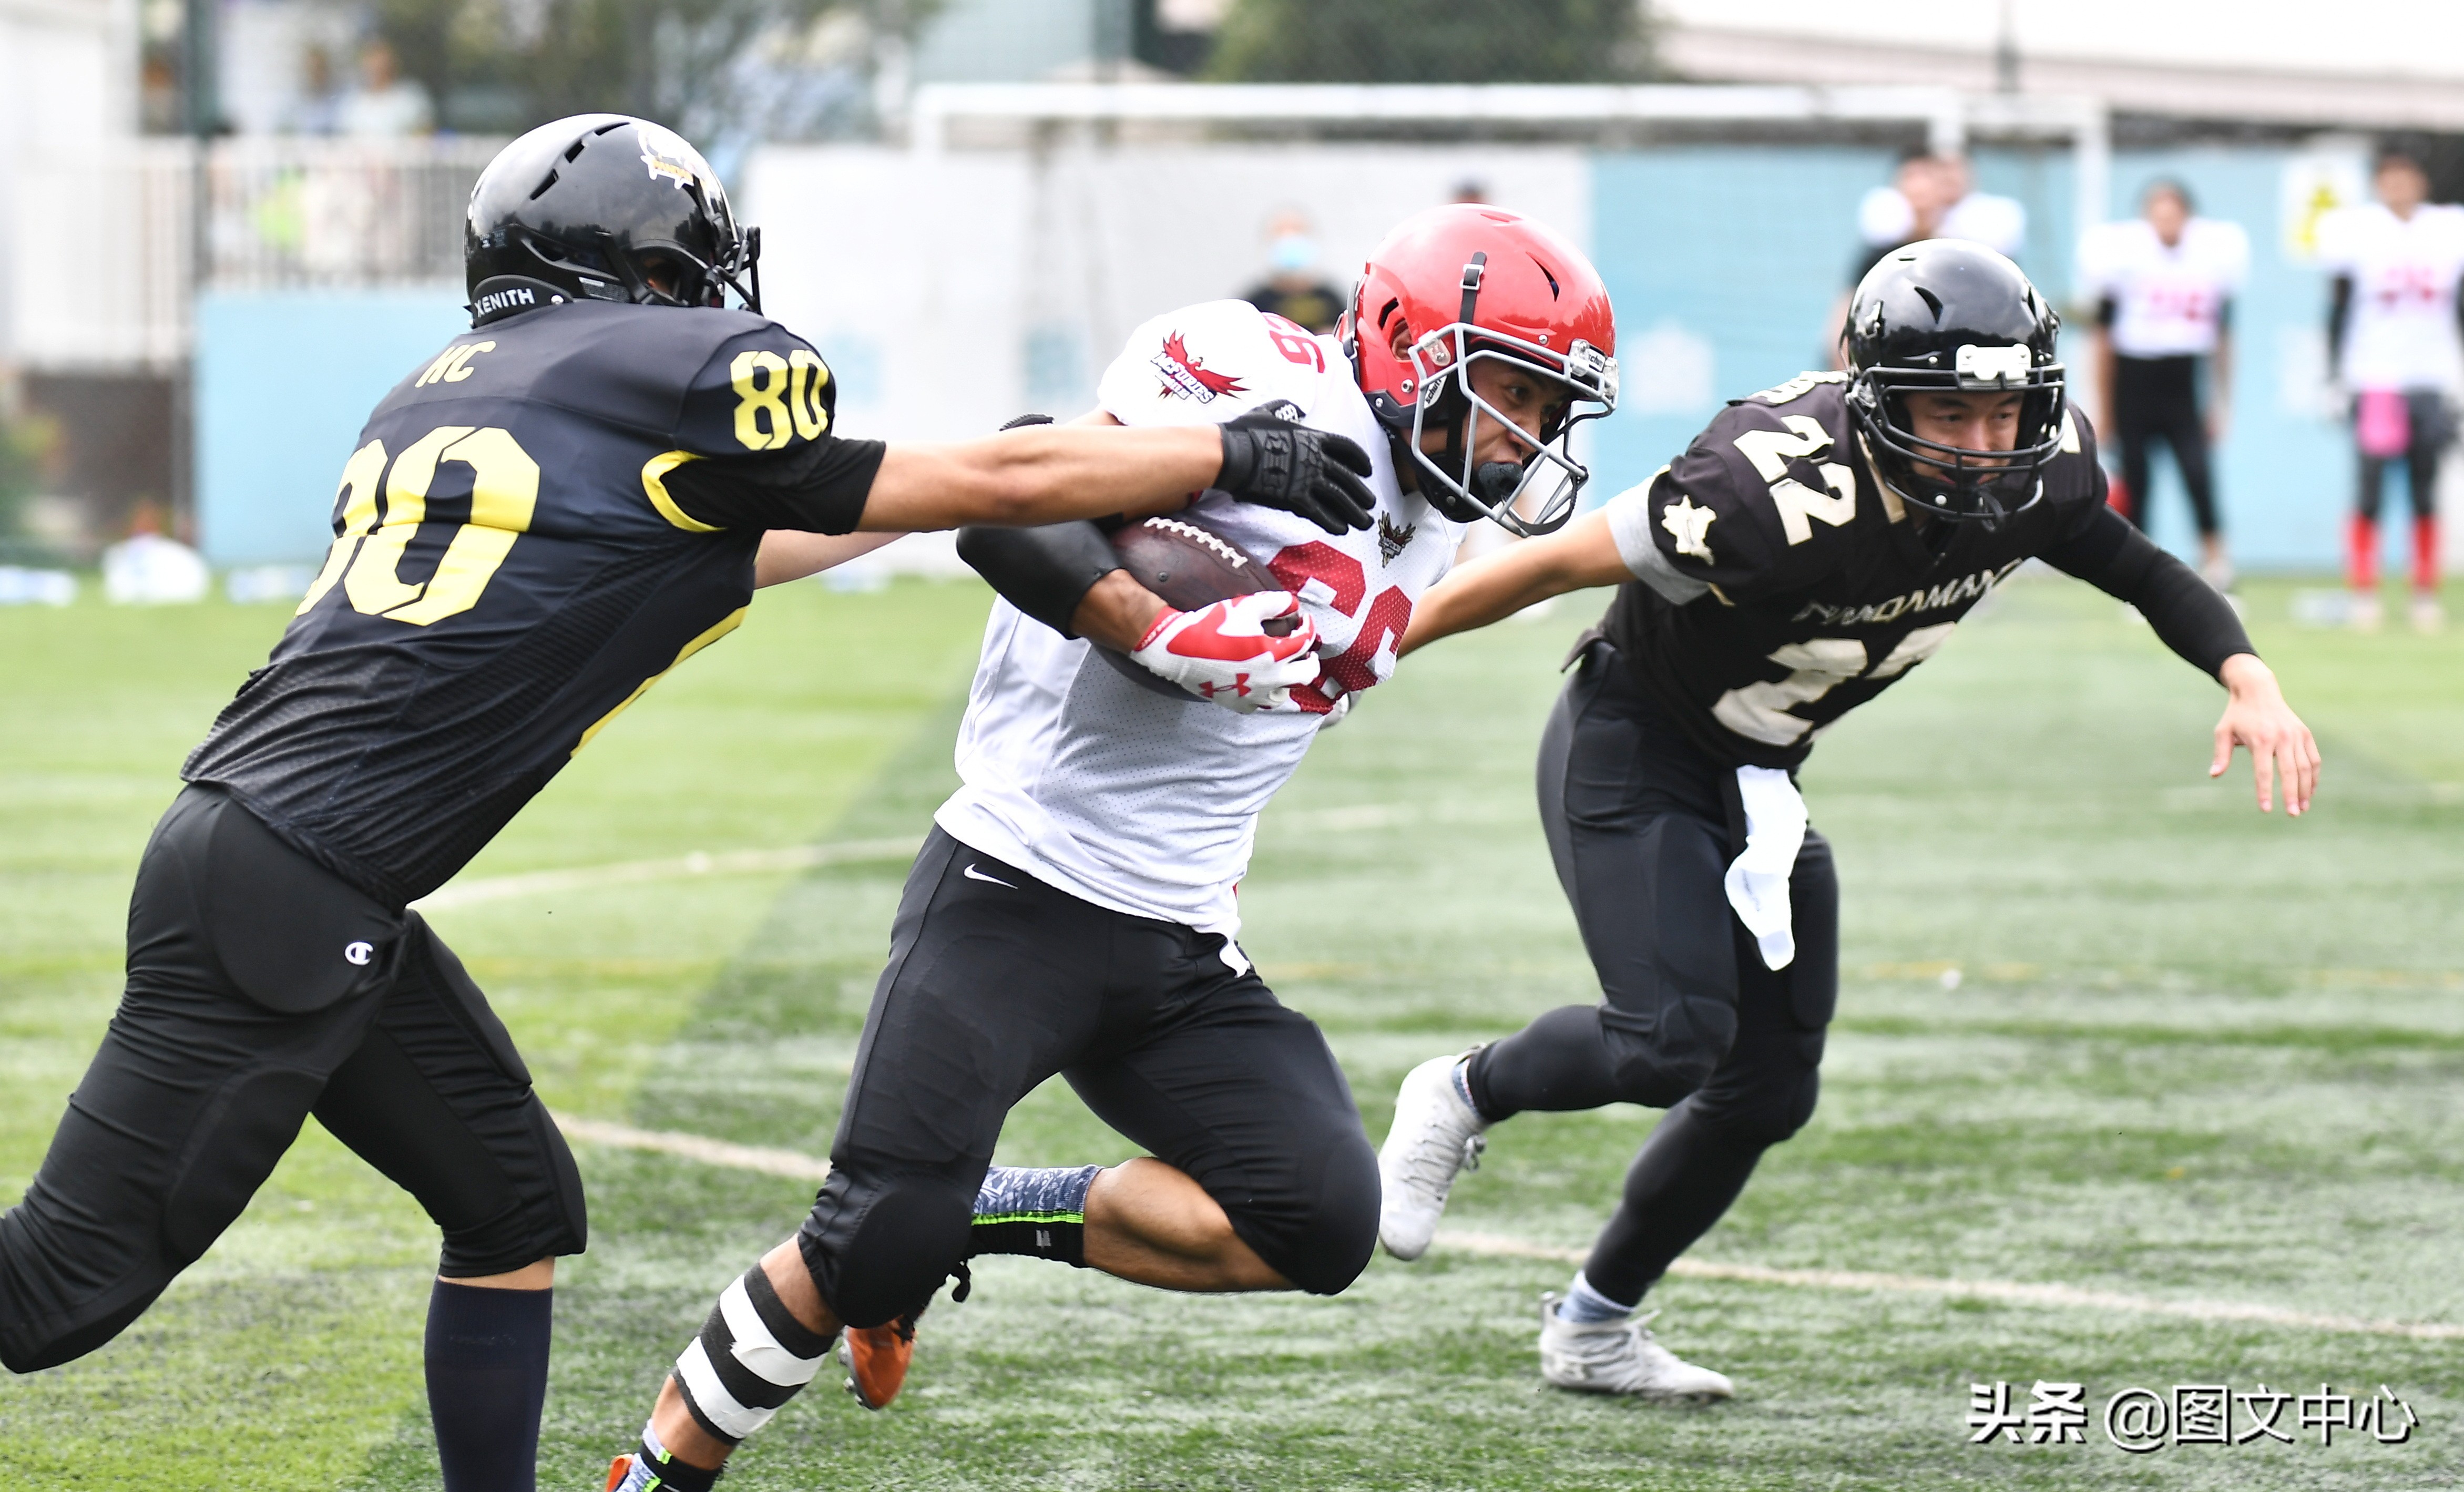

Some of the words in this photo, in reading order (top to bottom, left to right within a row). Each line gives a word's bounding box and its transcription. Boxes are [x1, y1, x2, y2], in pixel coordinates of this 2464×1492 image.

[474, 289, 535, 318] XENITH
[730, 350, 830, 451] 80
[1733, 414, 1856, 546] 22
